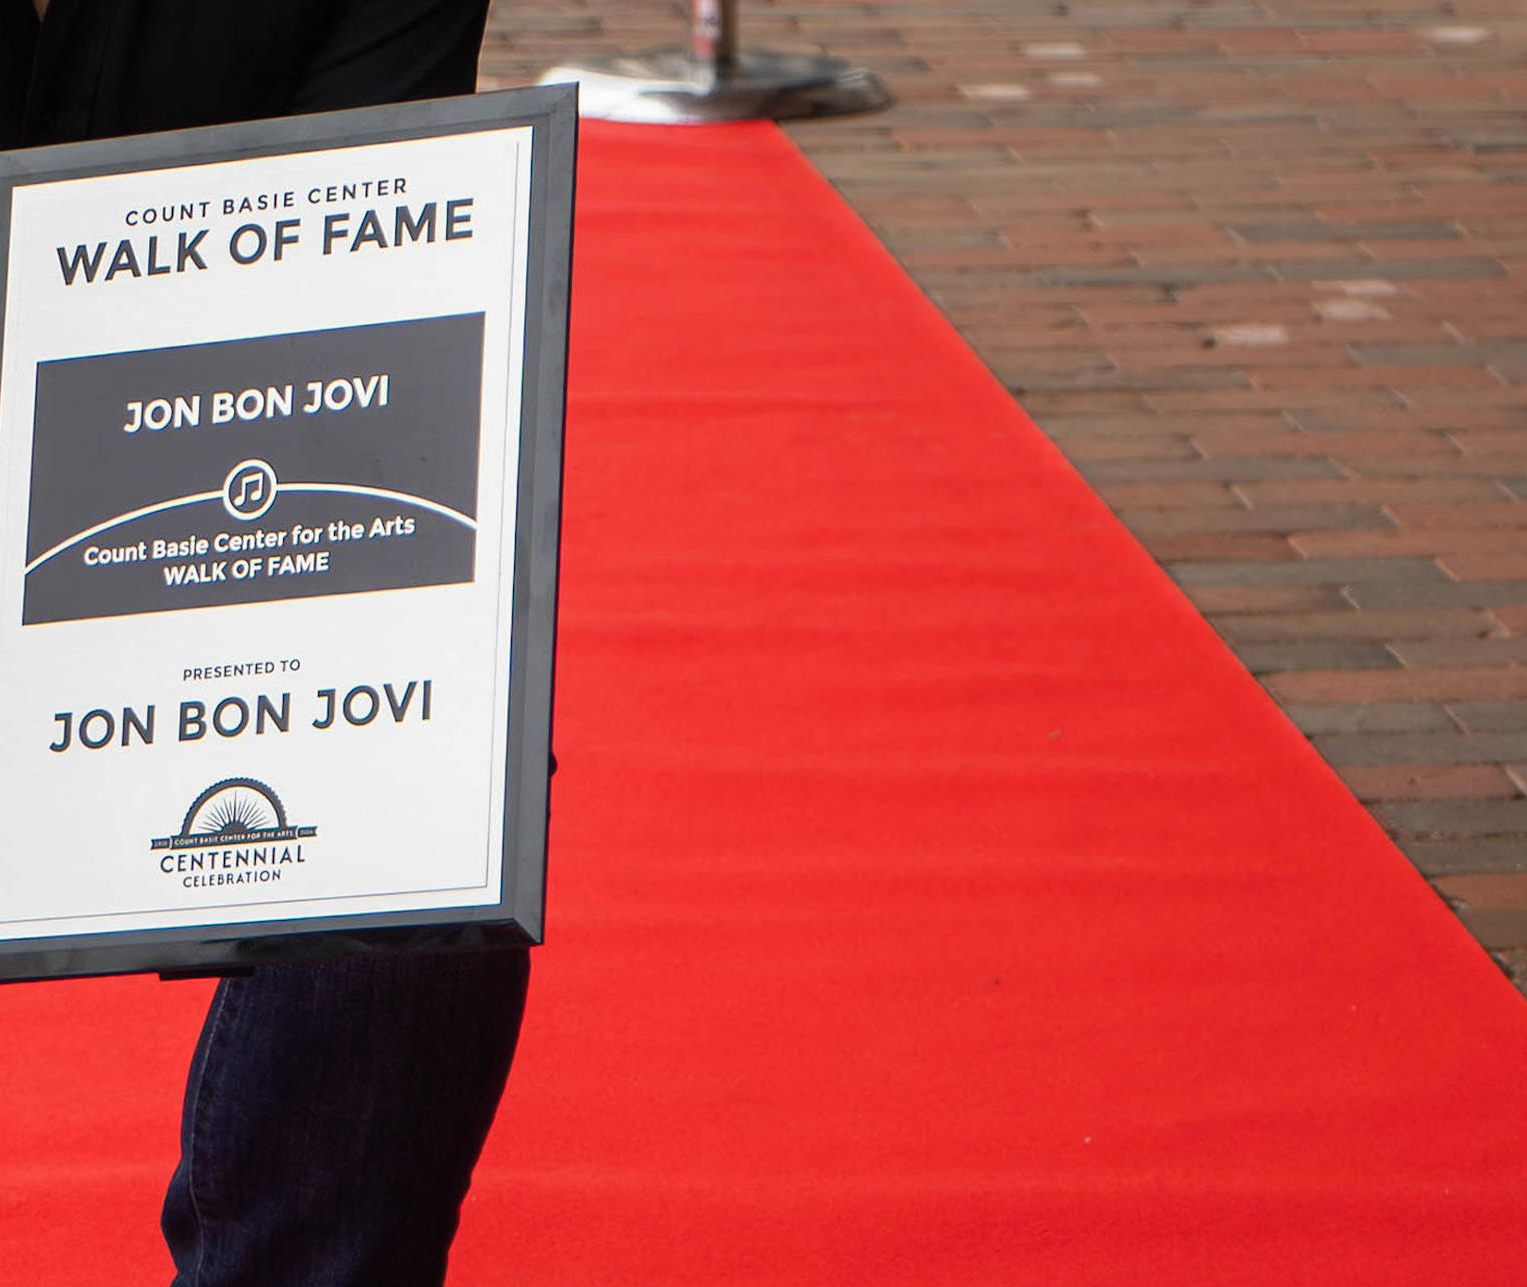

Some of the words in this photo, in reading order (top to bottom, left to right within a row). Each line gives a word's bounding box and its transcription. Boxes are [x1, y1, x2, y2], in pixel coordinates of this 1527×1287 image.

[125, 201, 211, 226] COUNT
[223, 191, 295, 215] BASIE
[308, 177, 407, 204] CENTER
[56, 229, 210, 286] WALK
[229, 218, 301, 265] OF
[322, 198, 474, 255] FAME
[123, 395, 200, 433] JON
[211, 385, 294, 424] BON
[303, 375, 390, 414] JOVI
[84, 541, 147, 566] Count
[152, 535, 209, 560] Basie
[213, 528, 285, 554] Center
[291, 524, 323, 547] for
[328, 520, 365, 542] the
[369, 516, 416, 539] Arts
[163, 559, 226, 586] WALK
[232, 556, 262, 579] OF
[267, 551, 329, 577] FAME
[183, 661, 275, 681] PRESENTED
[280, 659, 301, 672] TO
[49, 704, 156, 753] JON
[178, 692, 291, 743] BON
[312, 679, 433, 730] JOVI
[160, 845, 305, 873] CENTENNIAL
[183, 869, 281, 888] CELEBRATION
